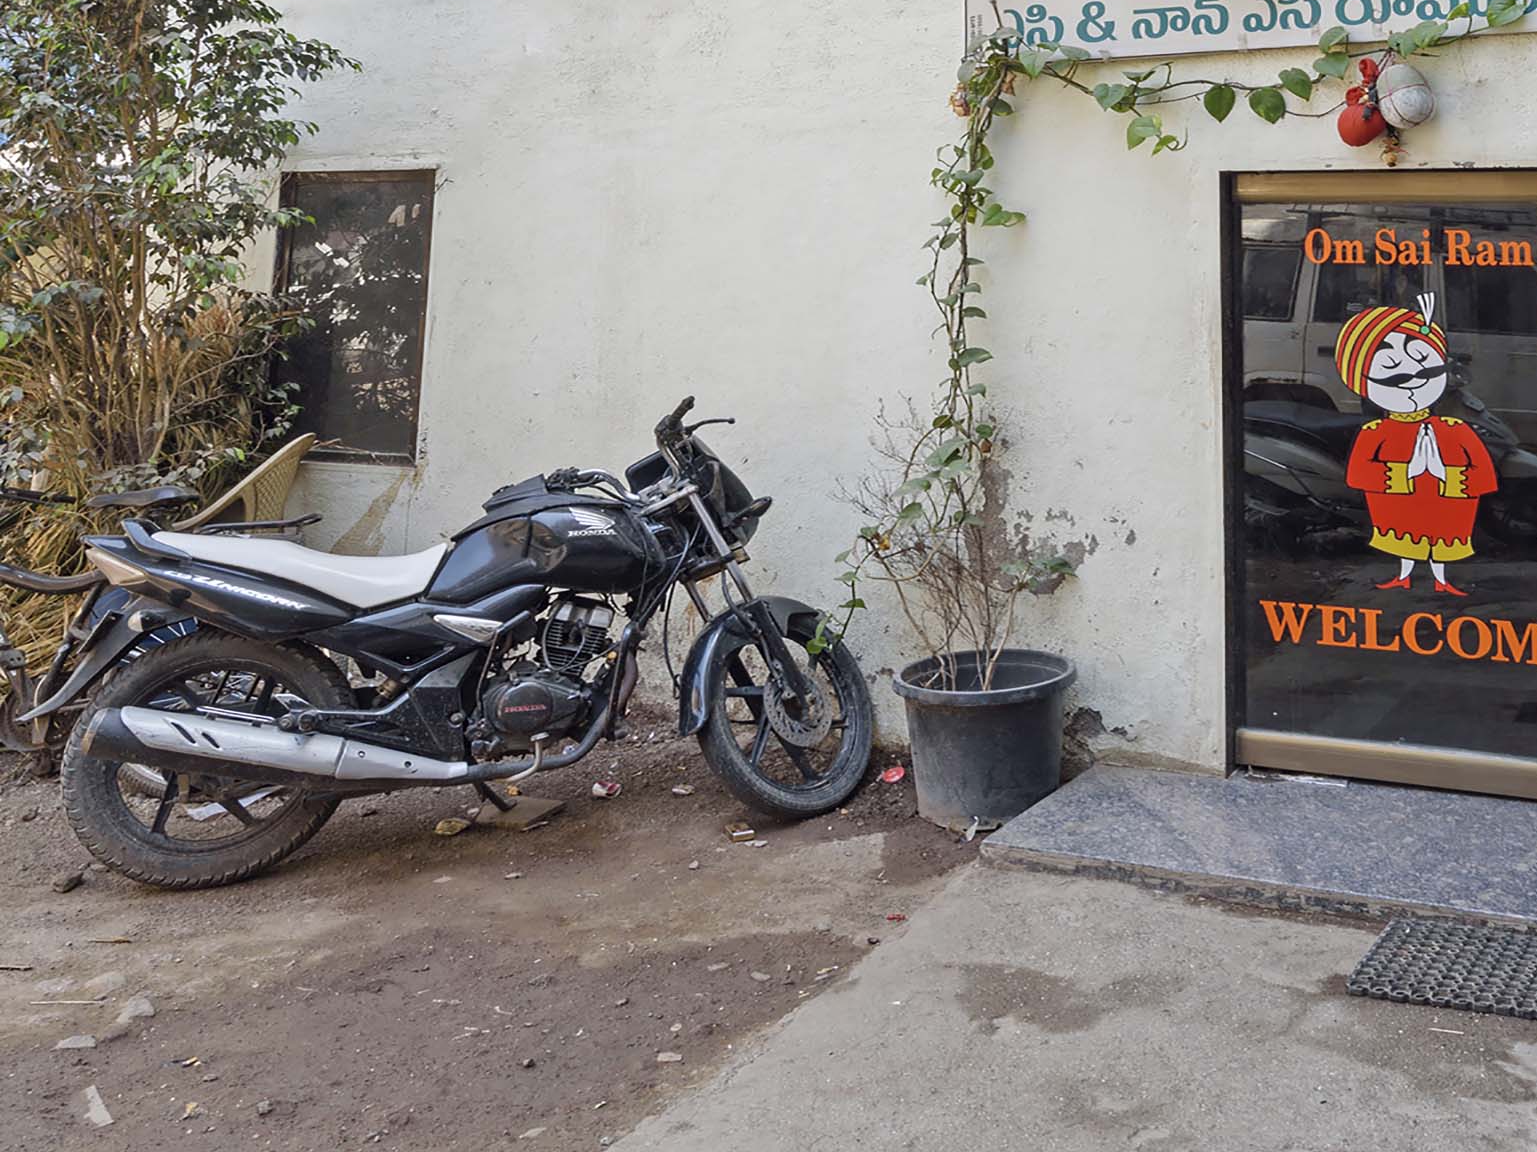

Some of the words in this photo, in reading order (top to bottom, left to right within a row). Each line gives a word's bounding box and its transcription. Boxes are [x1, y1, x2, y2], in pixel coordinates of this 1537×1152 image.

[1076, 0, 1117, 43] &
[1304, 227, 1365, 265] Om
[1374, 227, 1433, 266] Sai
[1443, 228, 1534, 267] Ram
[567, 529, 617, 537] HONDA
[504, 704, 546, 713] HONDA
